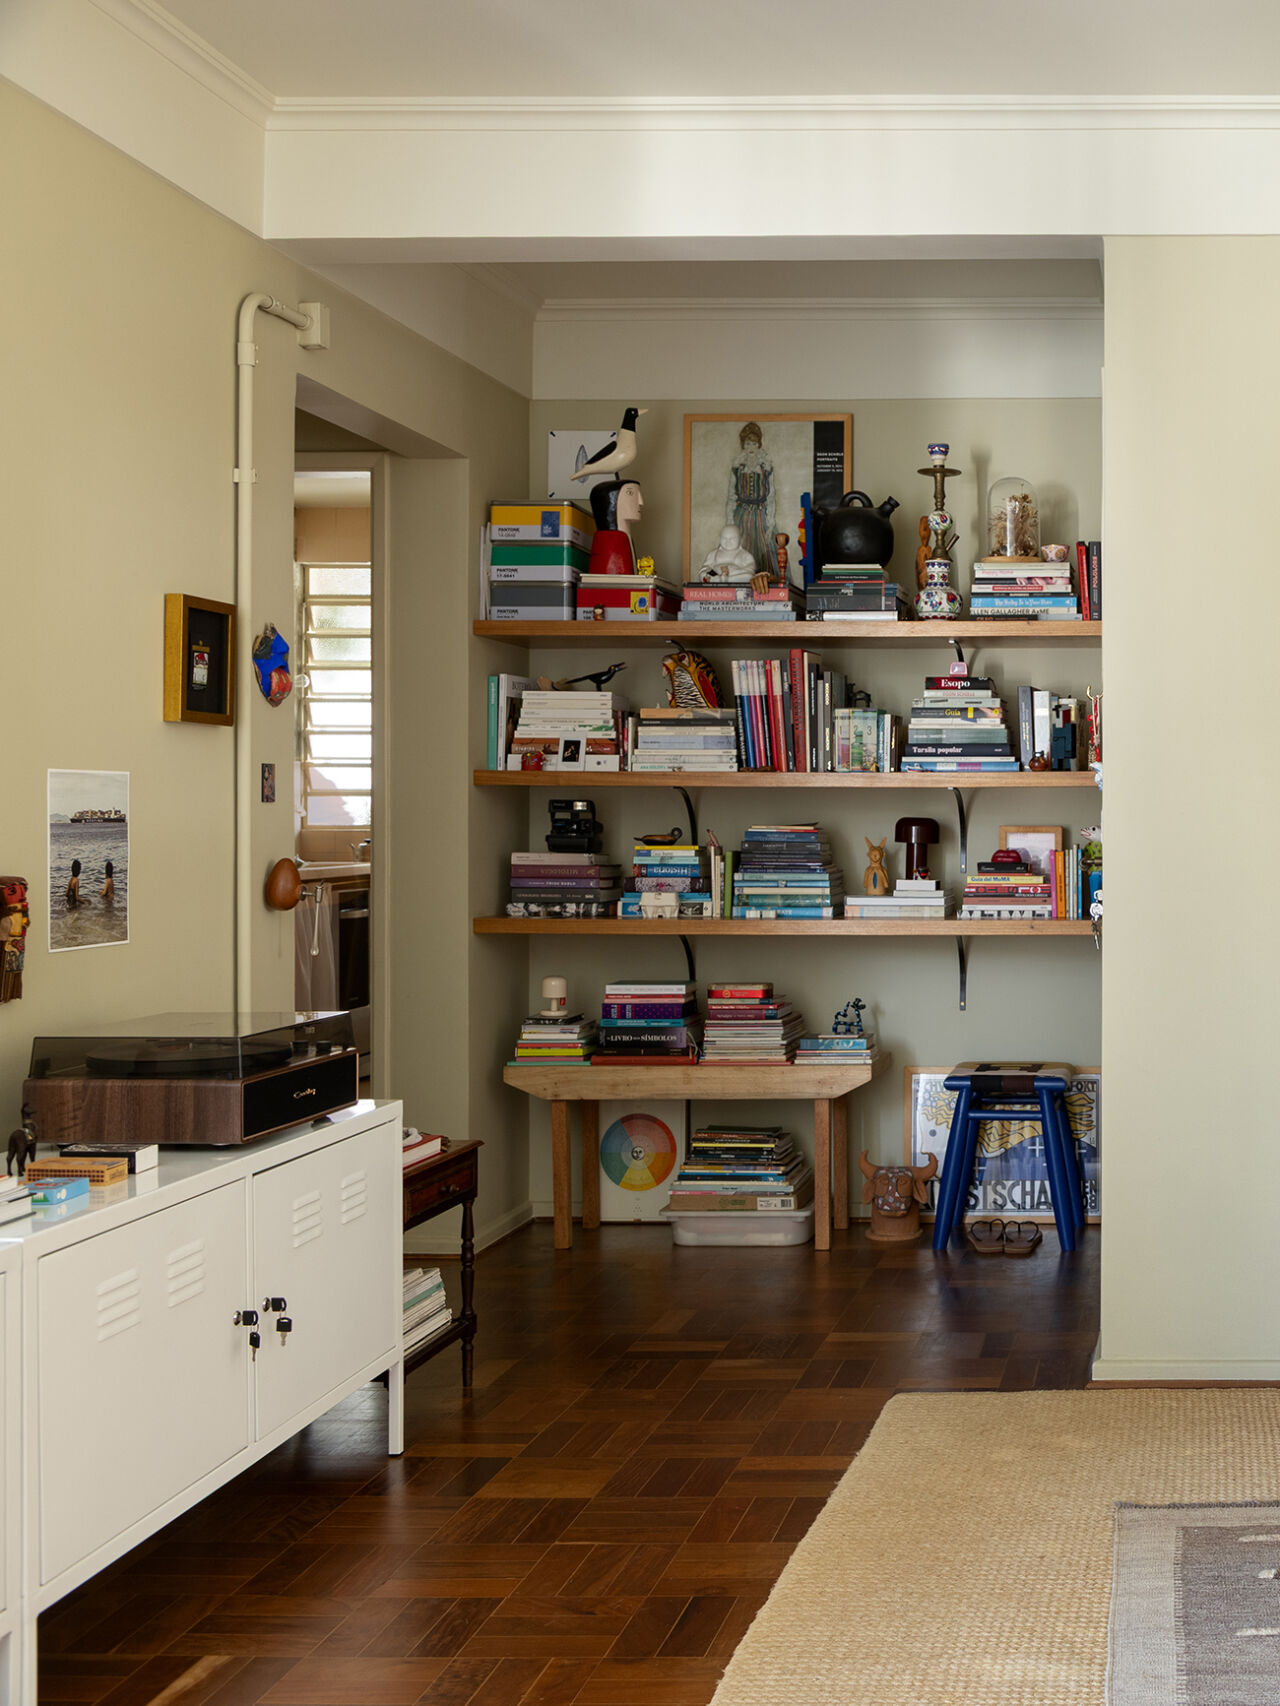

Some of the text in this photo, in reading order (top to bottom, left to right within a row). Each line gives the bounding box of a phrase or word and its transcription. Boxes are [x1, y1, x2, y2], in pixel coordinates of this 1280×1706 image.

[941, 679, 971, 689] Esopo
[912, 746, 963, 755] Tarsila popular
[640, 1033, 678, 1041] SÍMBOLOS
